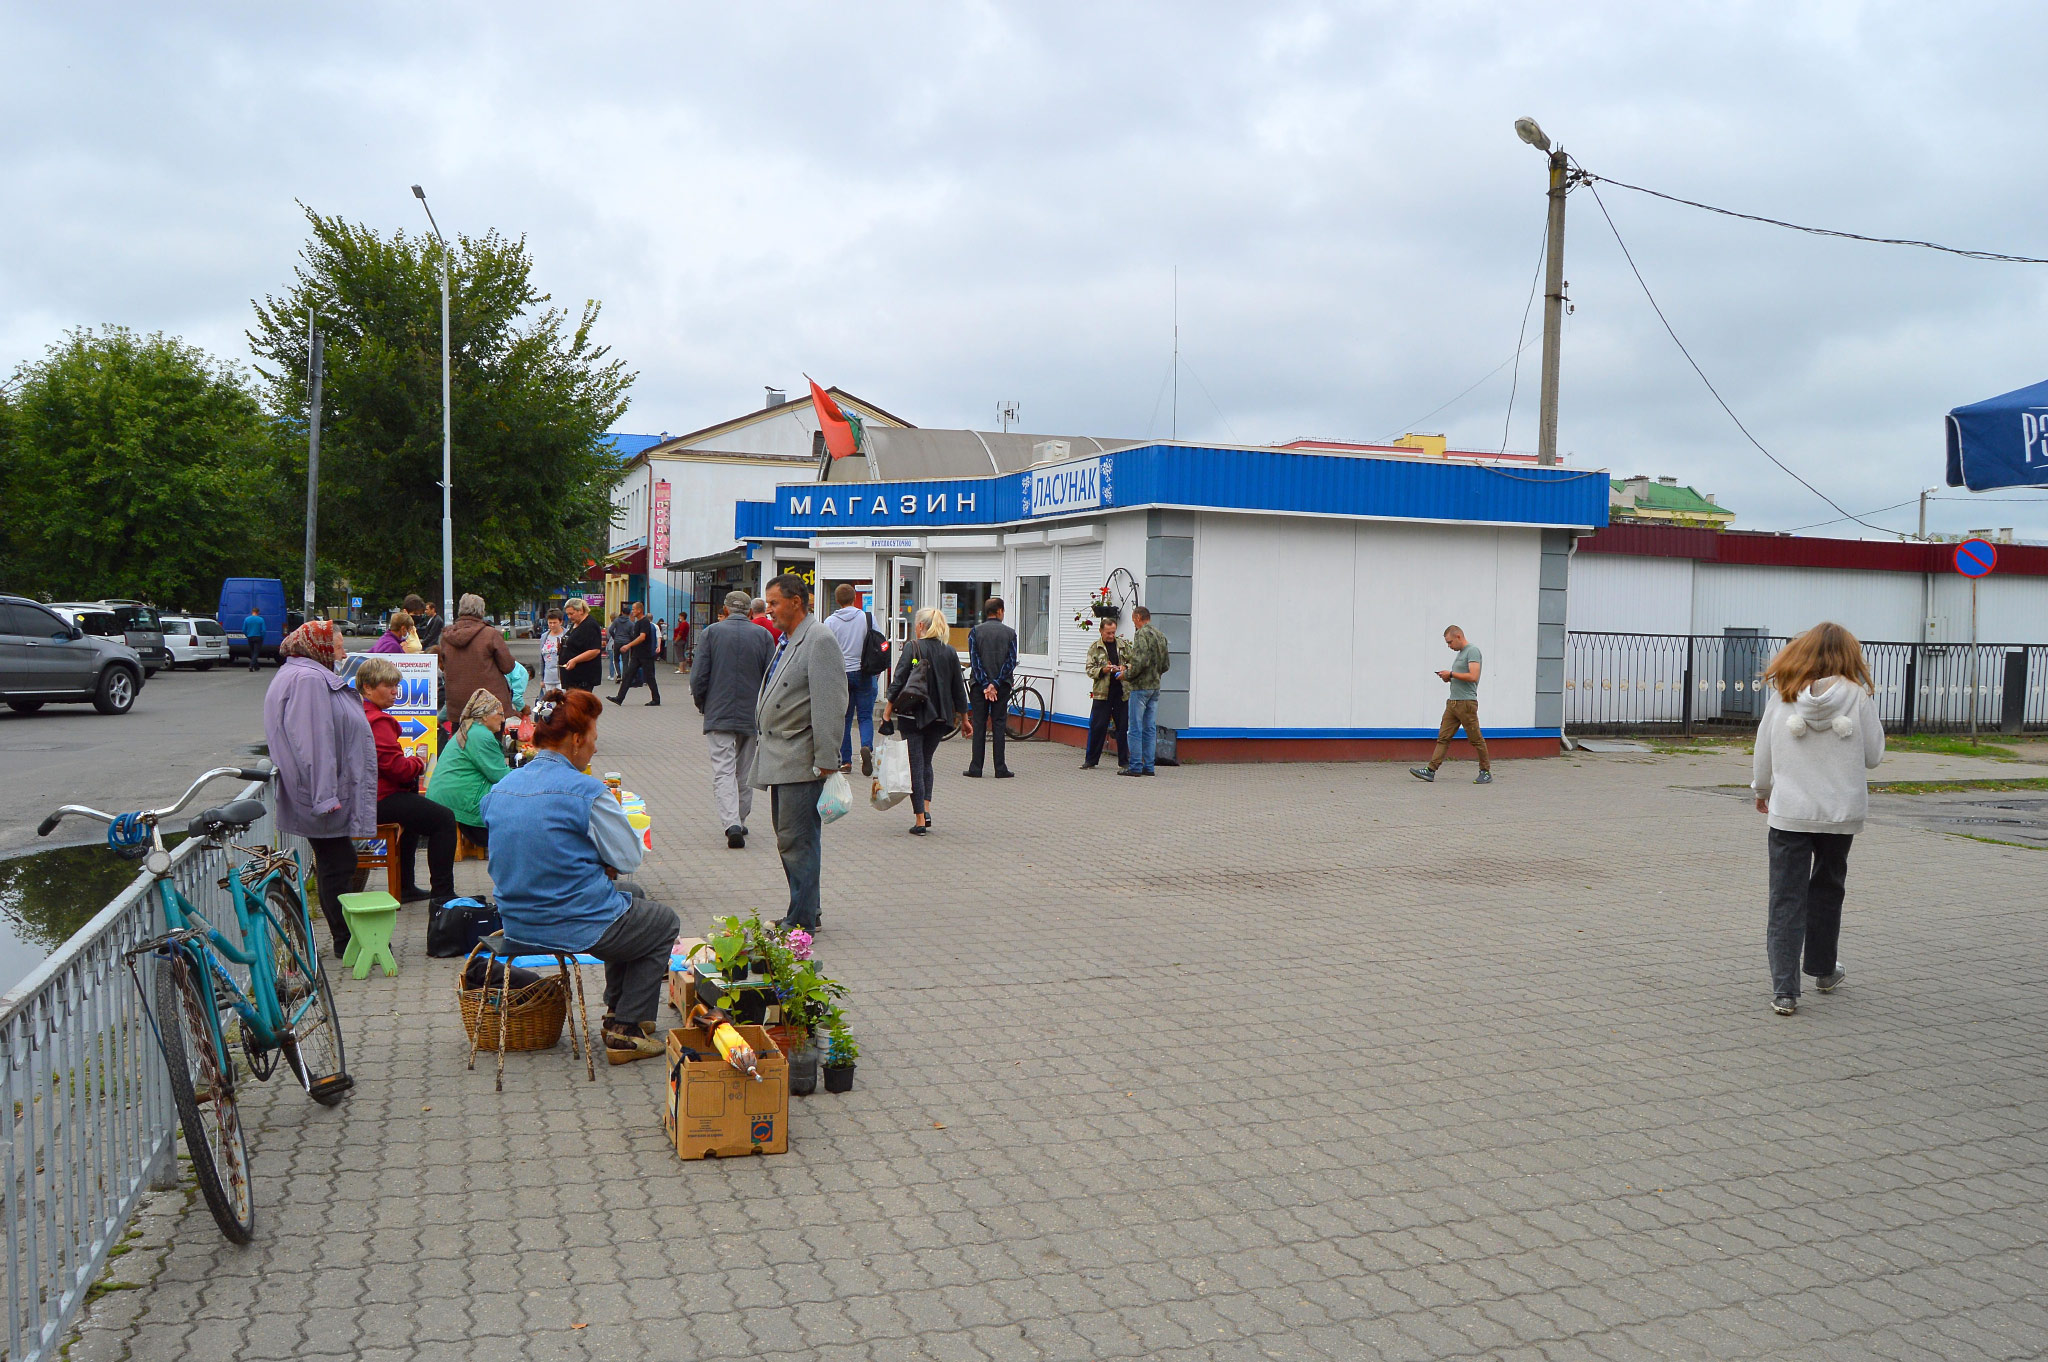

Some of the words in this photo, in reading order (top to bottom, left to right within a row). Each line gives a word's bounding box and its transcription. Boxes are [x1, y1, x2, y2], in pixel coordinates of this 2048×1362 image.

[1034, 467, 1097, 508] ЛАСУНАК
[790, 493, 976, 516] МАГАЗИН
[655, 501, 664, 566] ПРОДУКТЫ
[783, 565, 816, 585] Fst
[398, 661, 431, 669] переехали!
